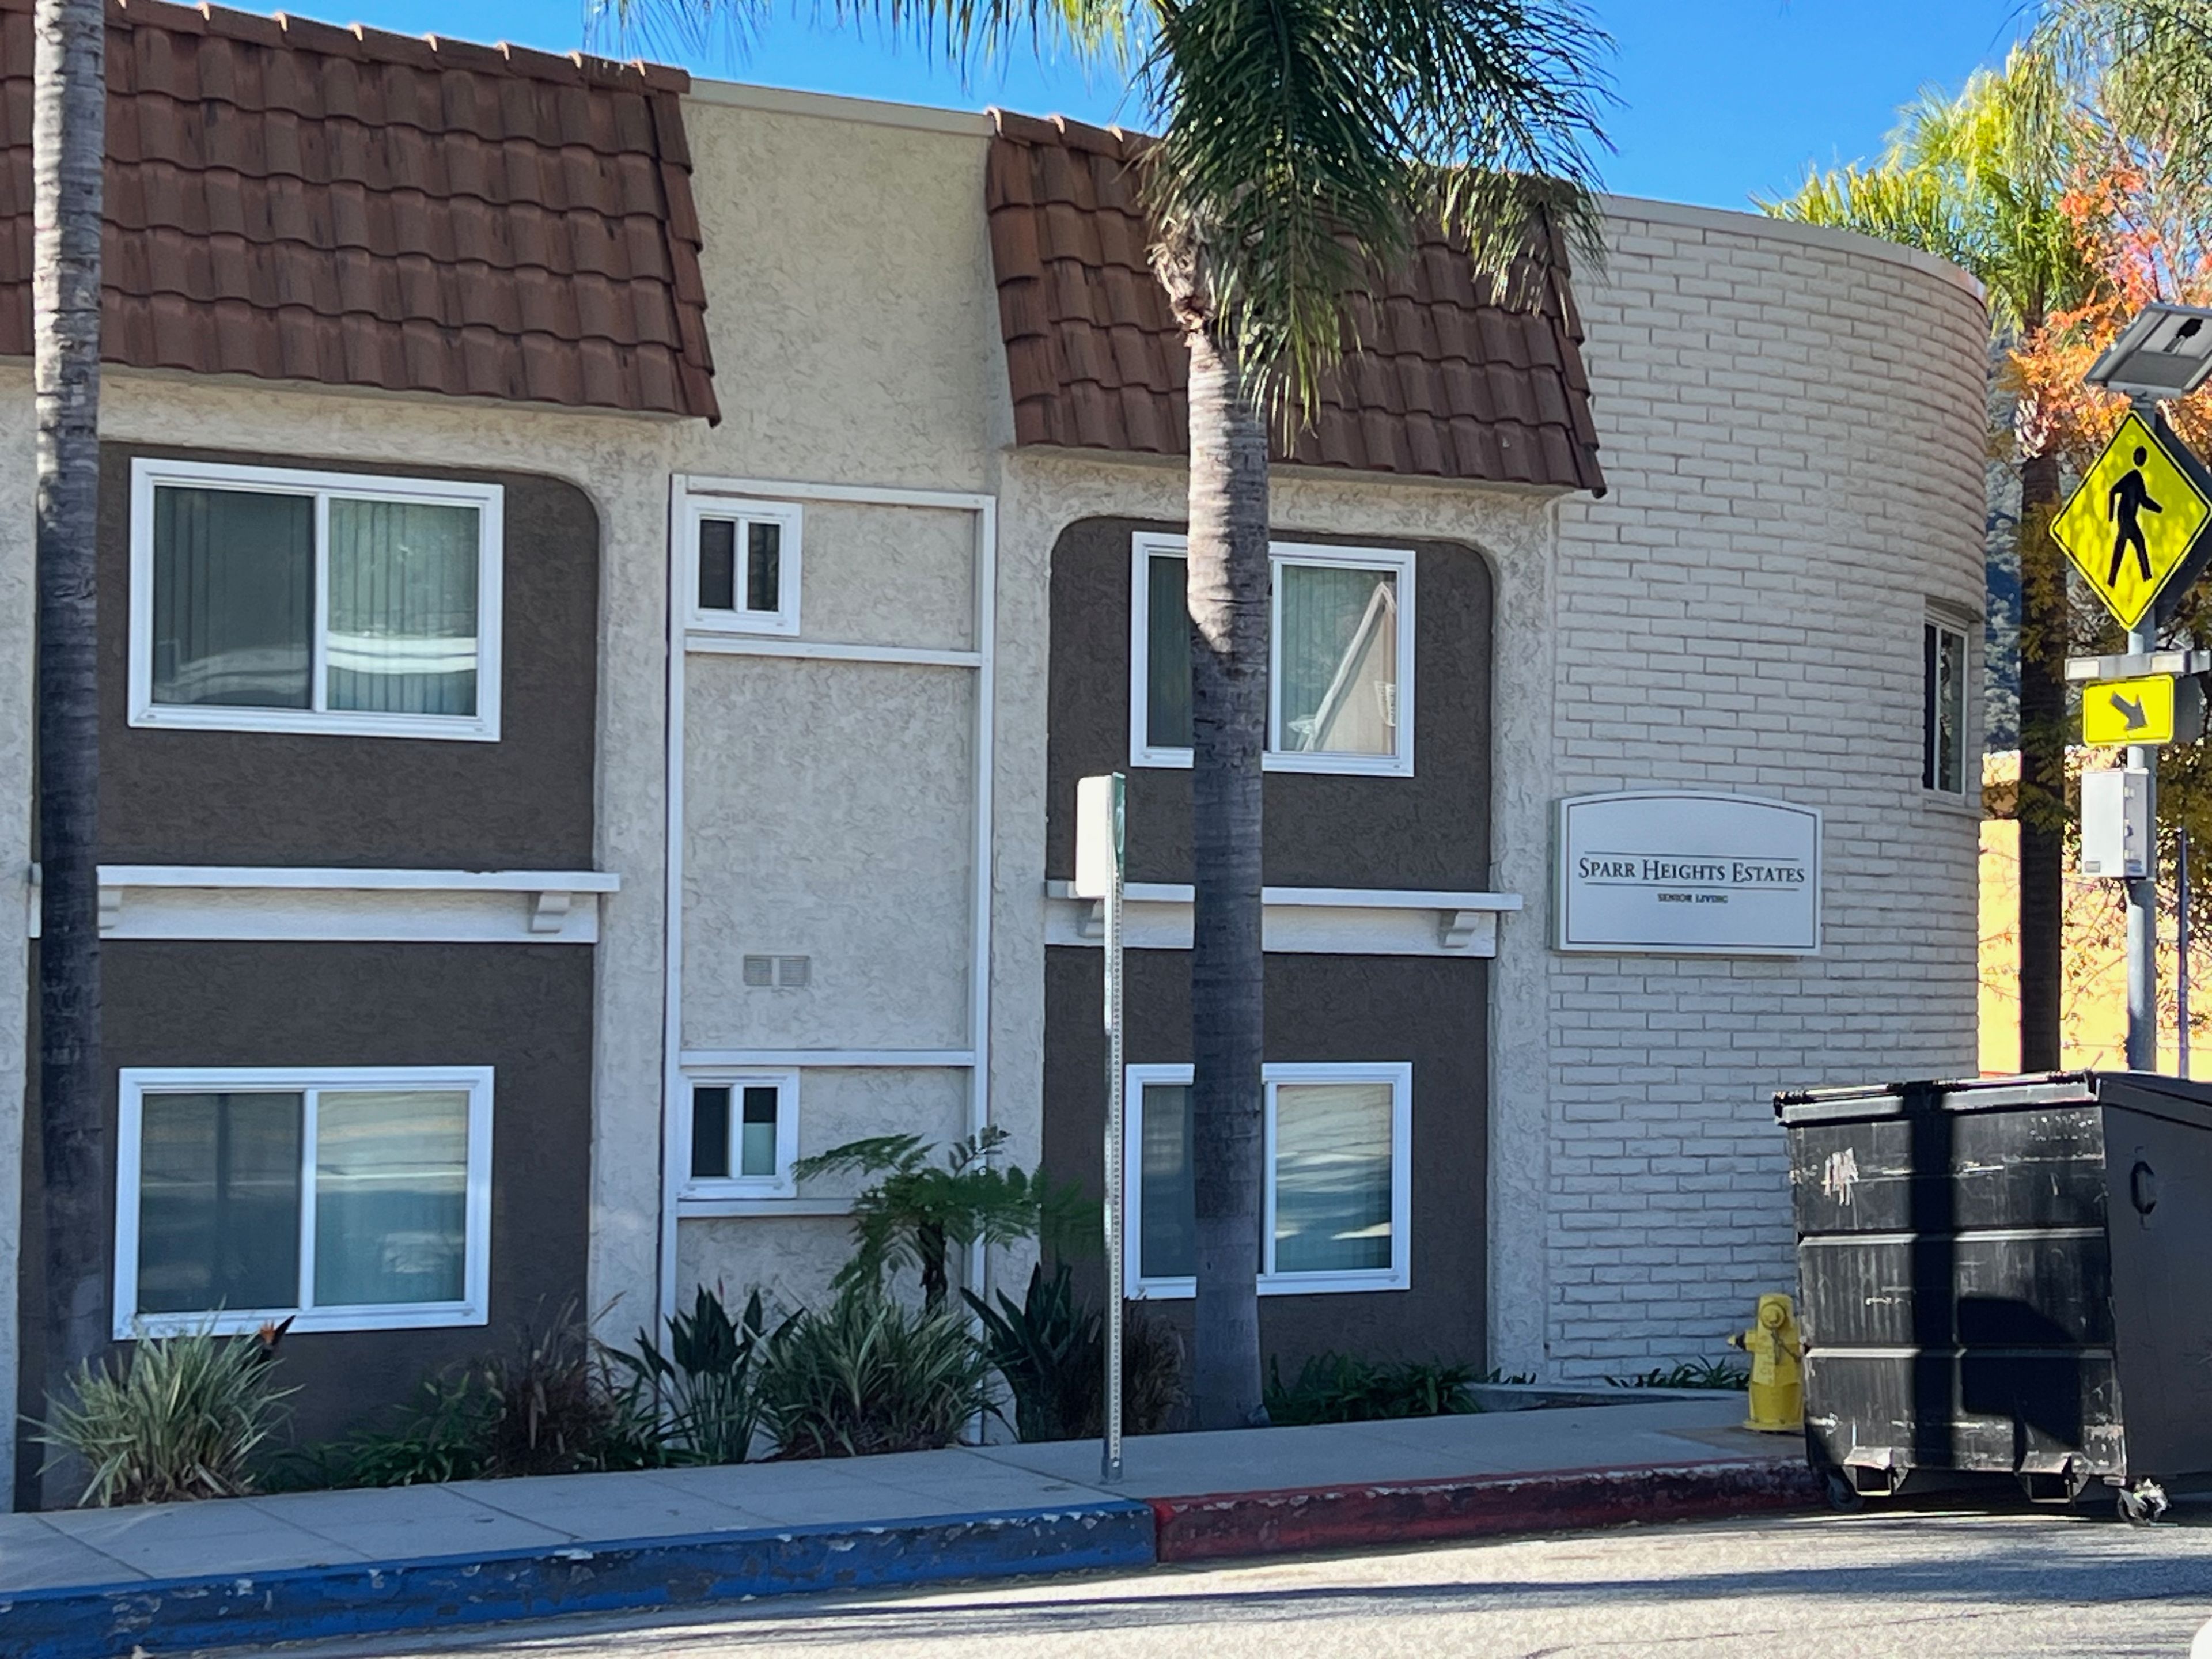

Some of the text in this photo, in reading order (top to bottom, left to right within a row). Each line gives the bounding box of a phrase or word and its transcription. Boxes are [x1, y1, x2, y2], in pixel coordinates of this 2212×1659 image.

[1578, 857, 1805, 883] SPARR HEIGHTS ESTATES
